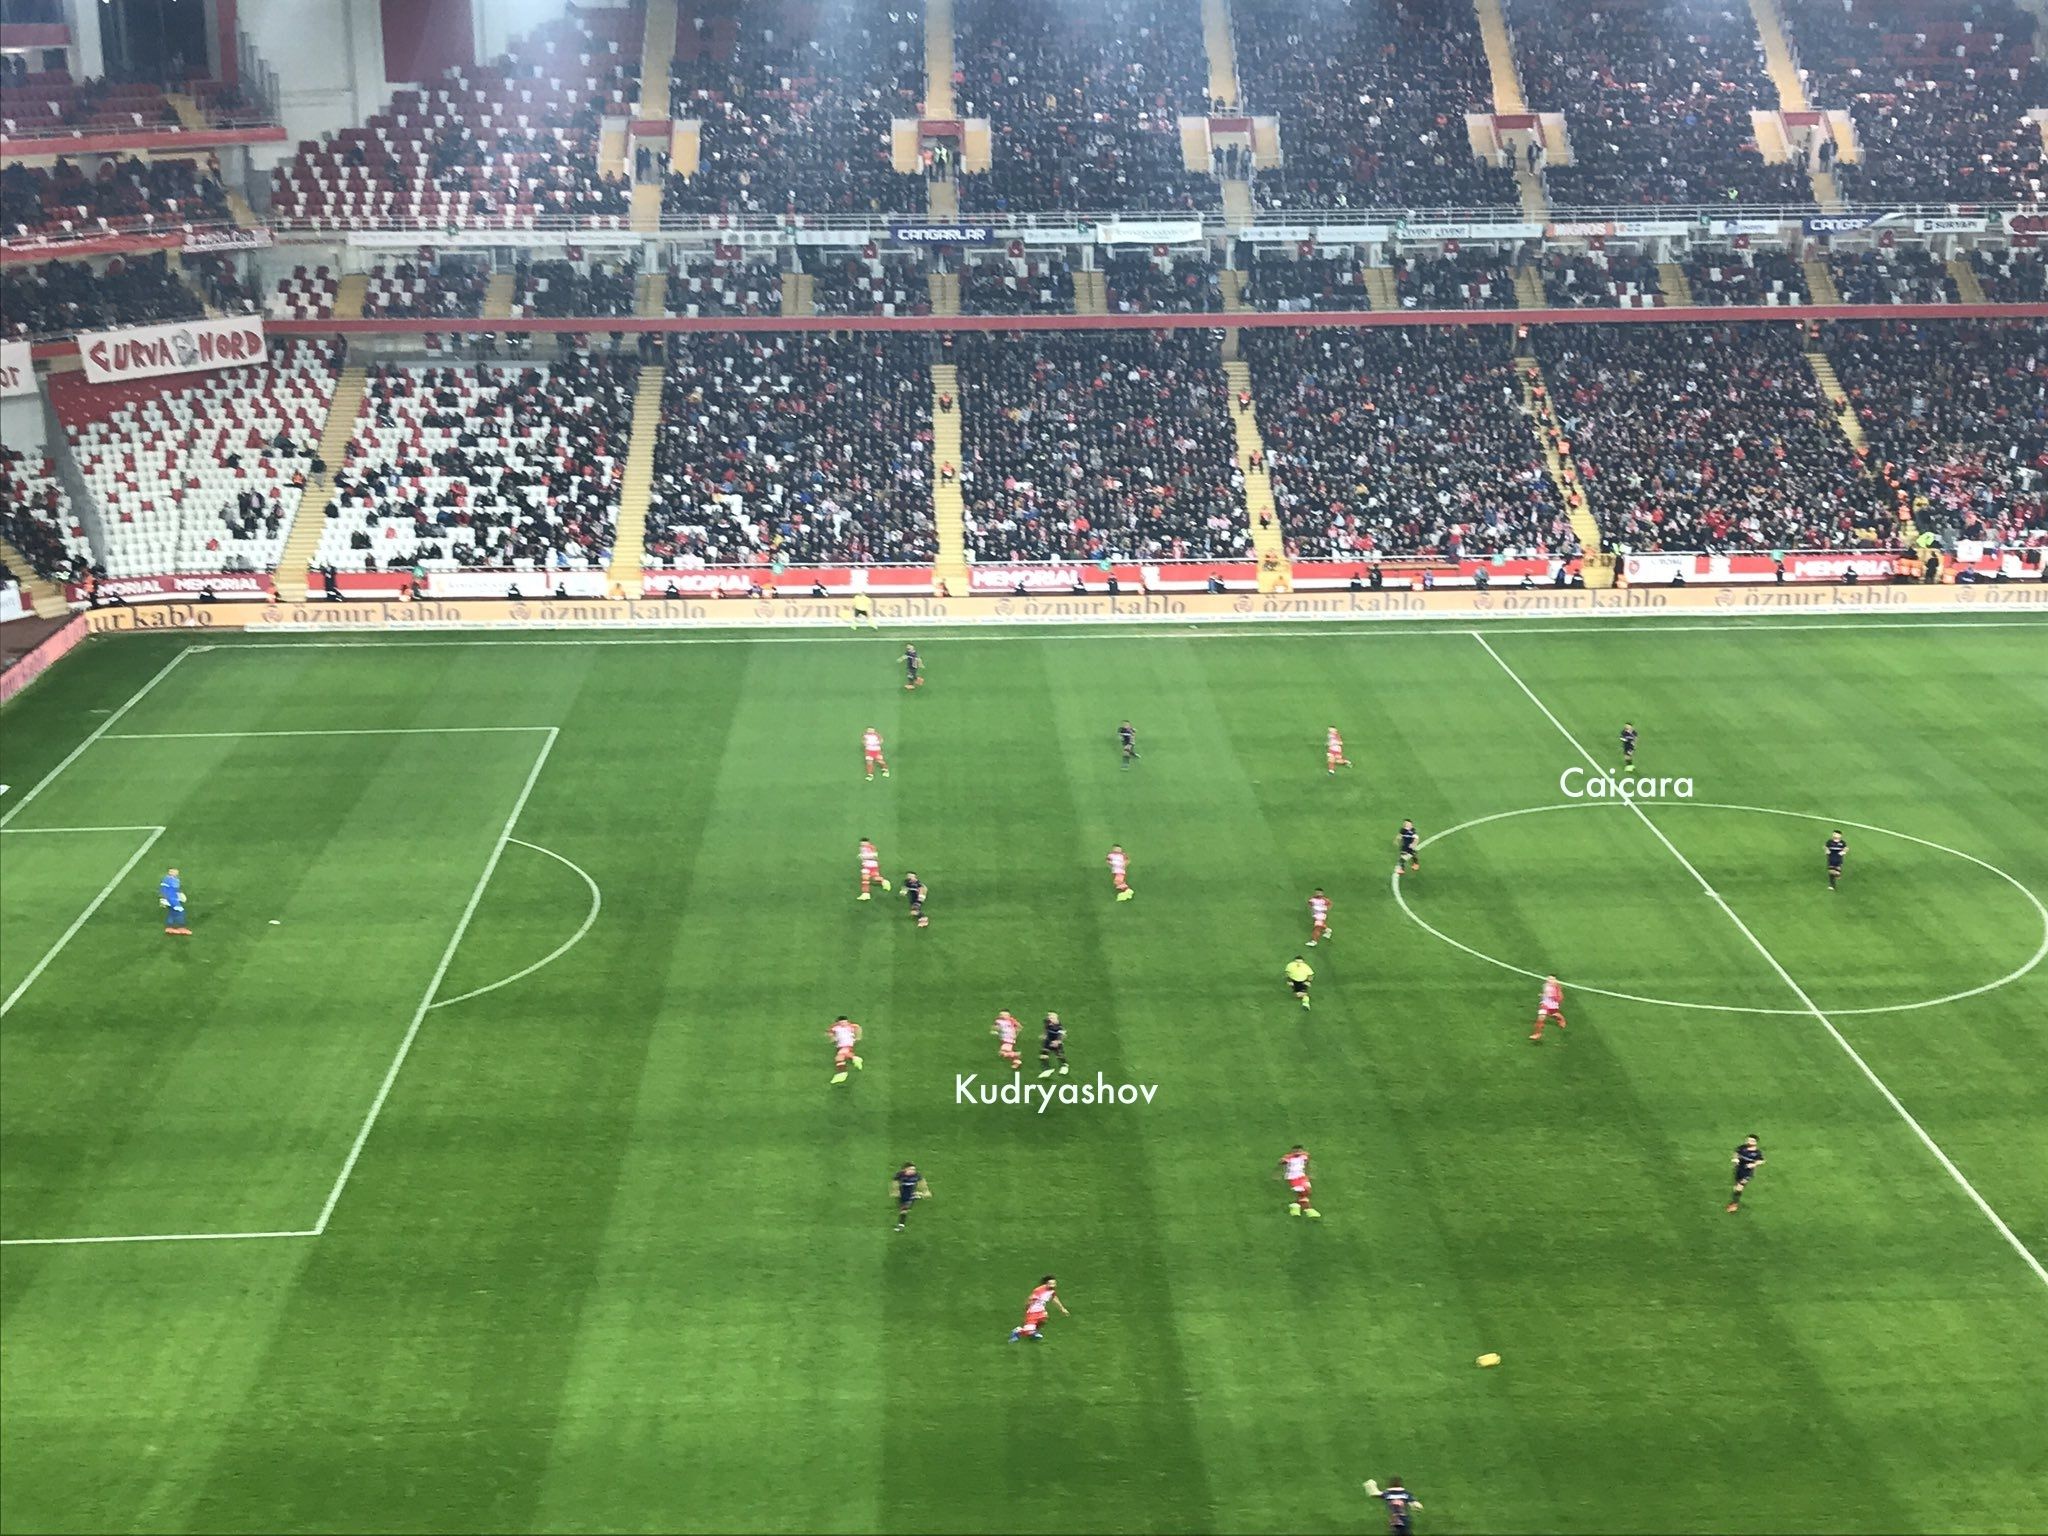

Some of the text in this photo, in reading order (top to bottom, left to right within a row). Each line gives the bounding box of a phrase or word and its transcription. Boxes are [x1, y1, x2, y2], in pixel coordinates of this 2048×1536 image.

[89, 329, 263, 373] CURVA NORD
[972, 569, 1080, 587] MEMORIAL
[75, 578, 164, 601] MMORIAL
[1504, 589, 1667, 610] öznur kablo
[1744, 586, 1908, 607] öznur kablo
[292, 601, 463, 623] öznur kablo
[540, 600, 707, 621] öznur kablo
[1024, 595, 1187, 616] öznur kablo
[1263, 592, 1426, 613] öznur kablo
[131, 605, 213, 628] kablo
